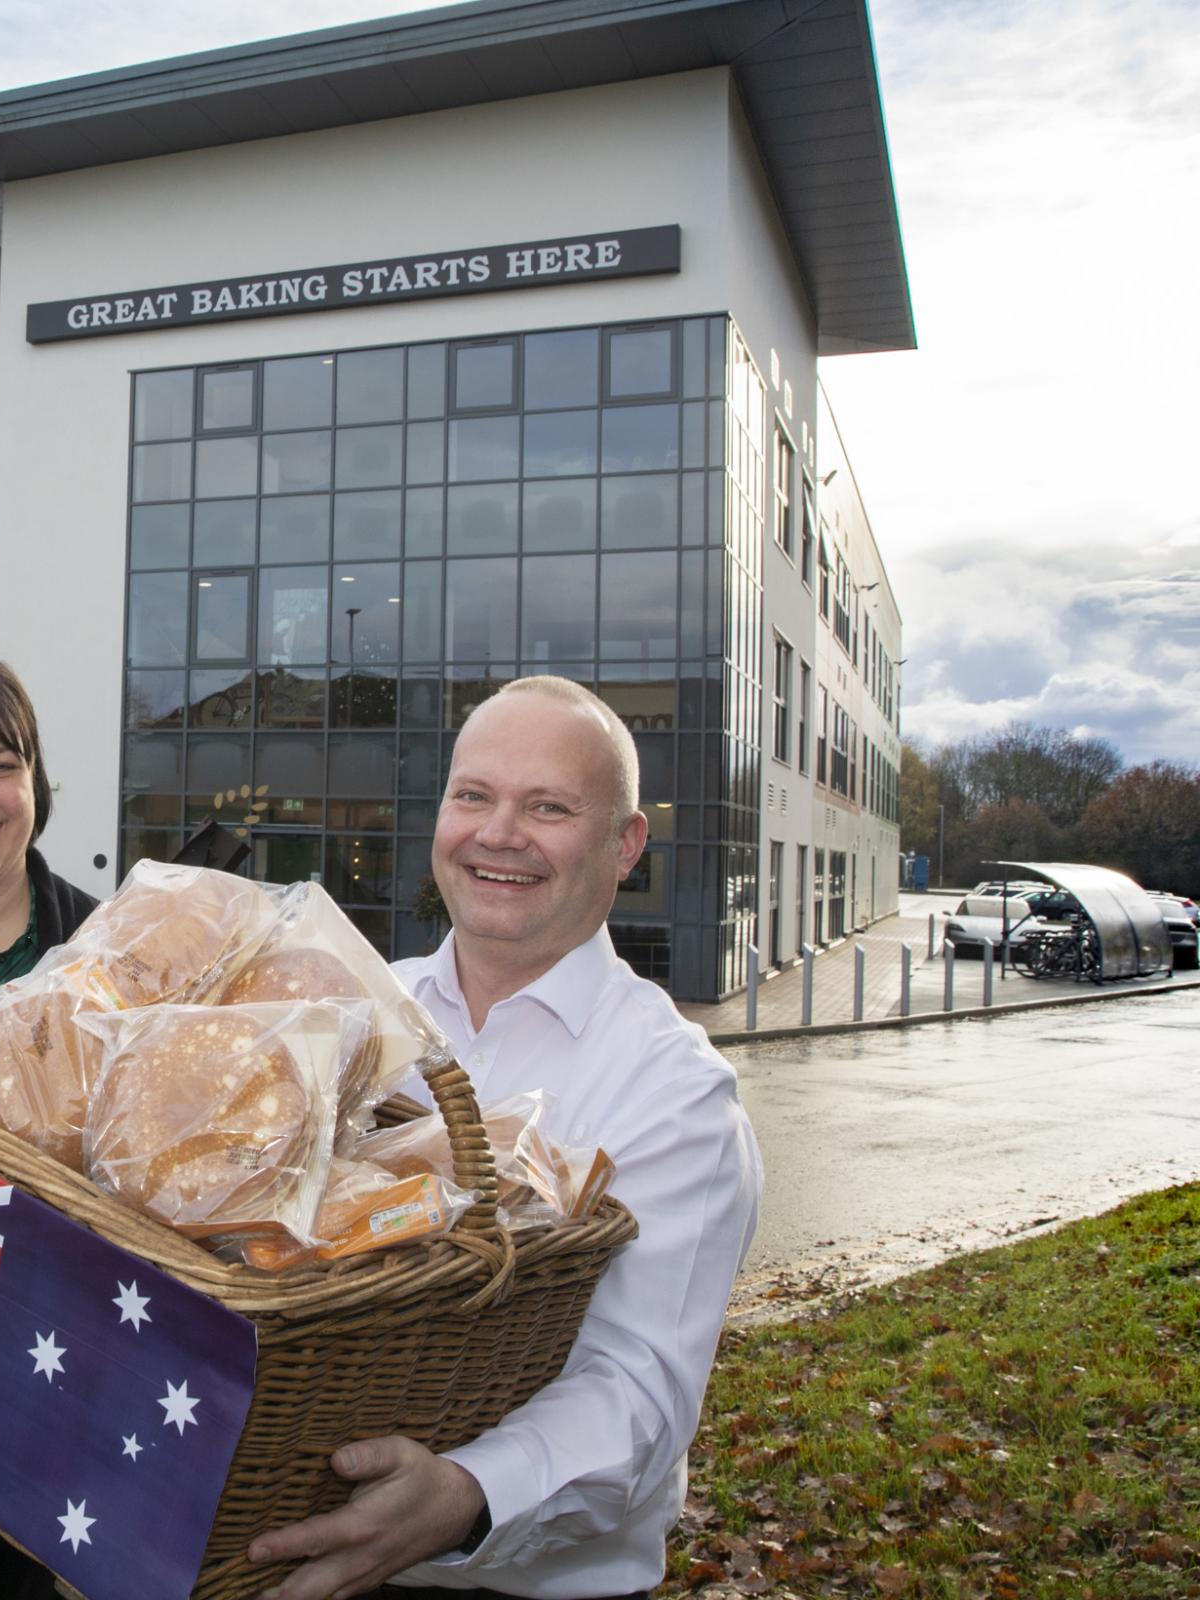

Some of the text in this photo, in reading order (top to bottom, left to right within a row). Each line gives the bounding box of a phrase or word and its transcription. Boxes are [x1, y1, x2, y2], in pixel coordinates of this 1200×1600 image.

[67, 240, 621, 328] GREAT BAKING STARTS HERE
